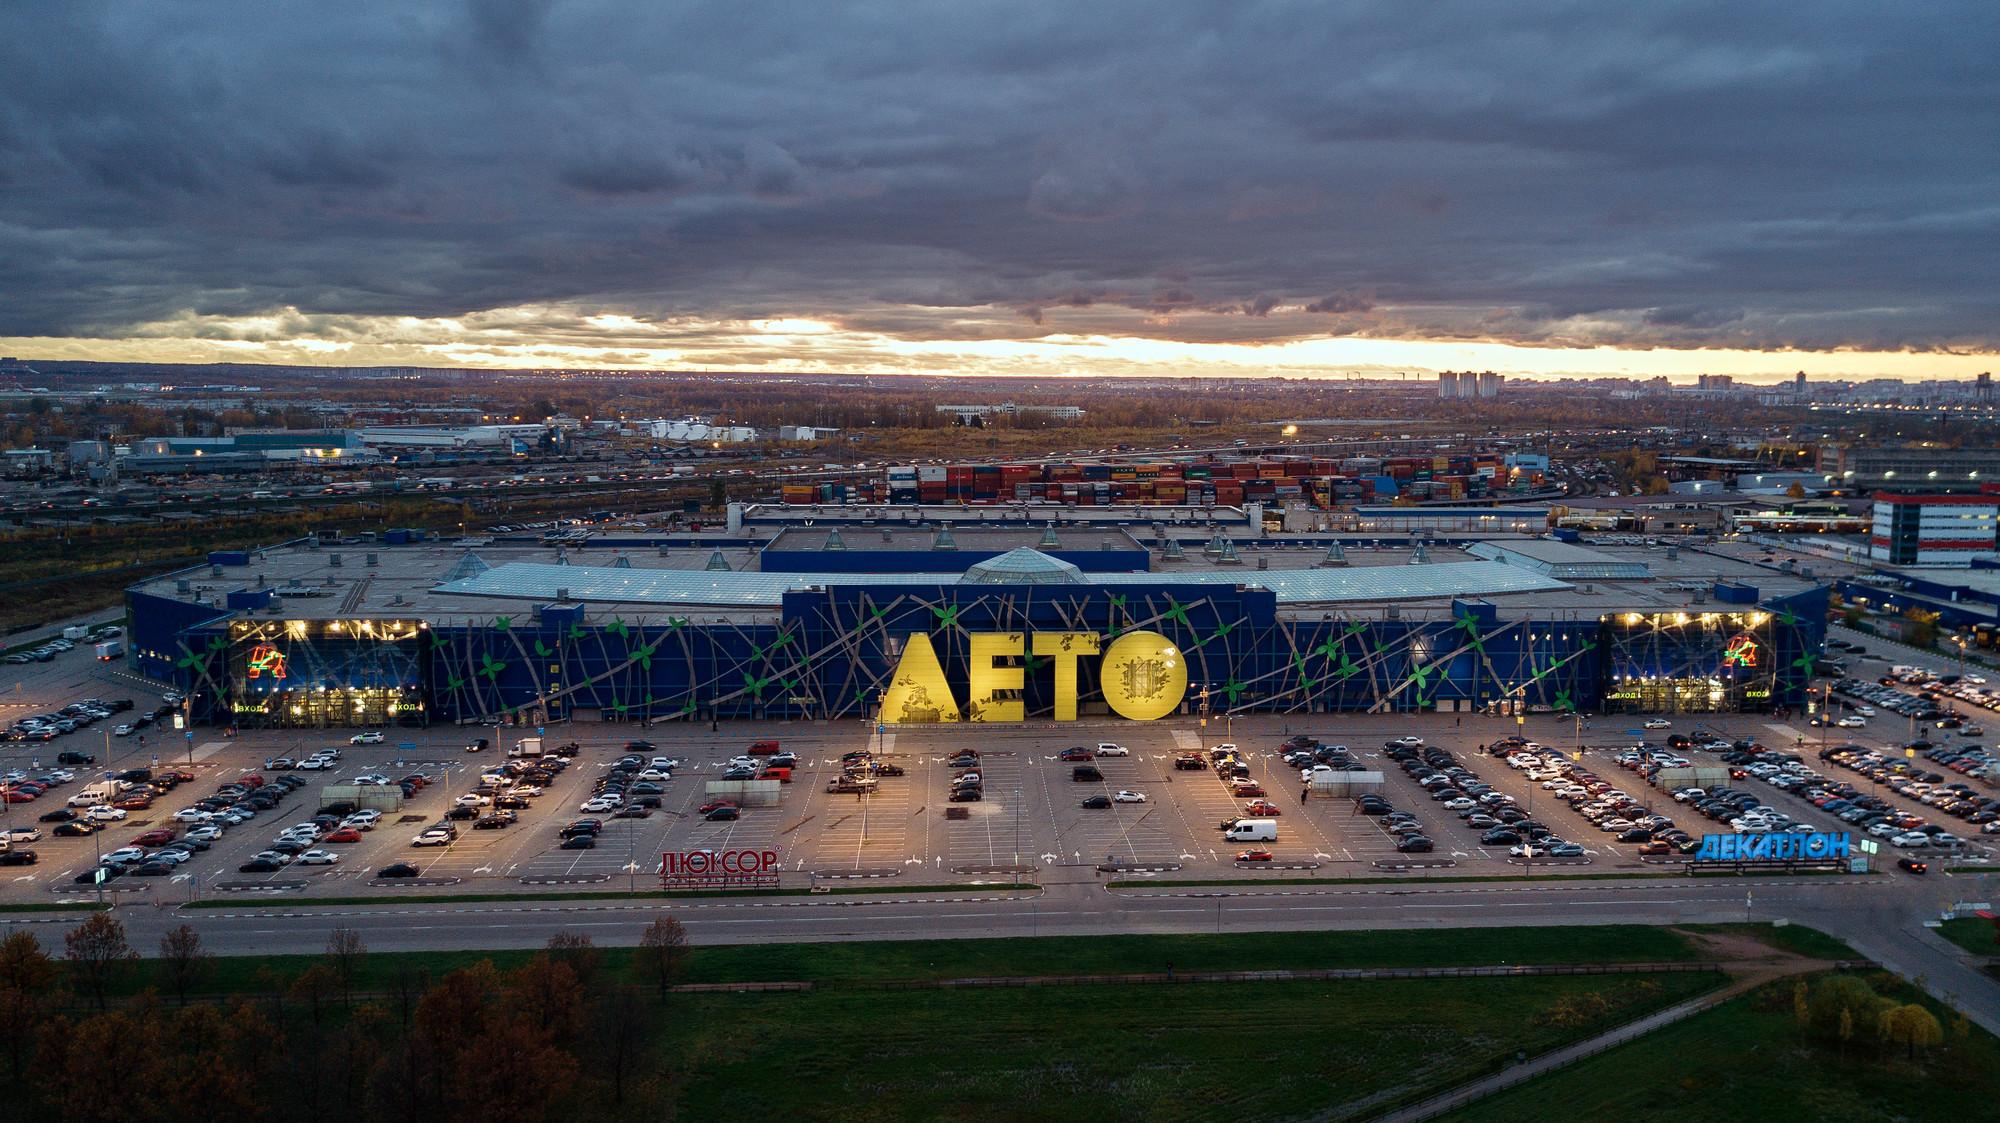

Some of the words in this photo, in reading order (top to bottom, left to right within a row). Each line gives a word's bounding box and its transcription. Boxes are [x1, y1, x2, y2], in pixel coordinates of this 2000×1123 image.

[877, 630, 1188, 722] ЛЕТО
[1695, 832, 1850, 861] ДЕКАТЛОН
[659, 850, 778, 875] ЛЮКСОР
